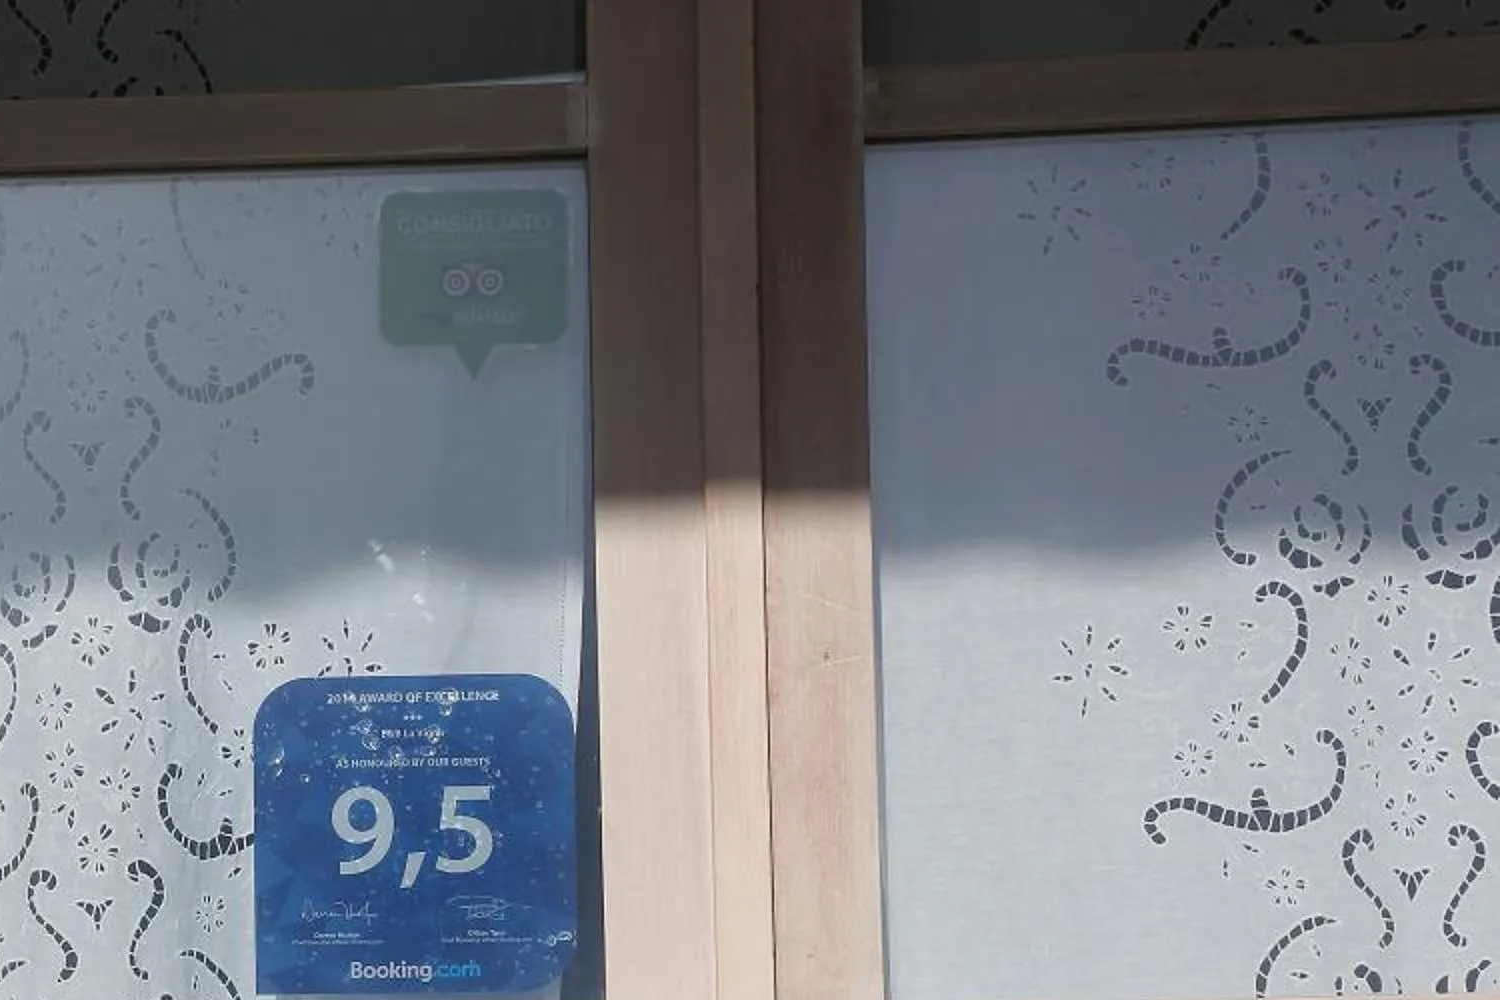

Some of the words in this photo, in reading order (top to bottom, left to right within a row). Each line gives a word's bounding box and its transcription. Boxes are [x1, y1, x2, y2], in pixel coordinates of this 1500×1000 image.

[359, 691, 401, 704] AWARD
[405, 691, 423, 703] OF
[426, 689, 500, 702] EXCELLENCE
[335, 758, 349, 769] AS
[351, 758, 410, 768] HONORED
[412, 757, 425, 767] BY
[427, 757, 449, 767] OUR
[451, 756, 491, 767] GUESTS
[331, 785, 493, 888] 9,5
[350, 960, 481, 983] Booking.com
